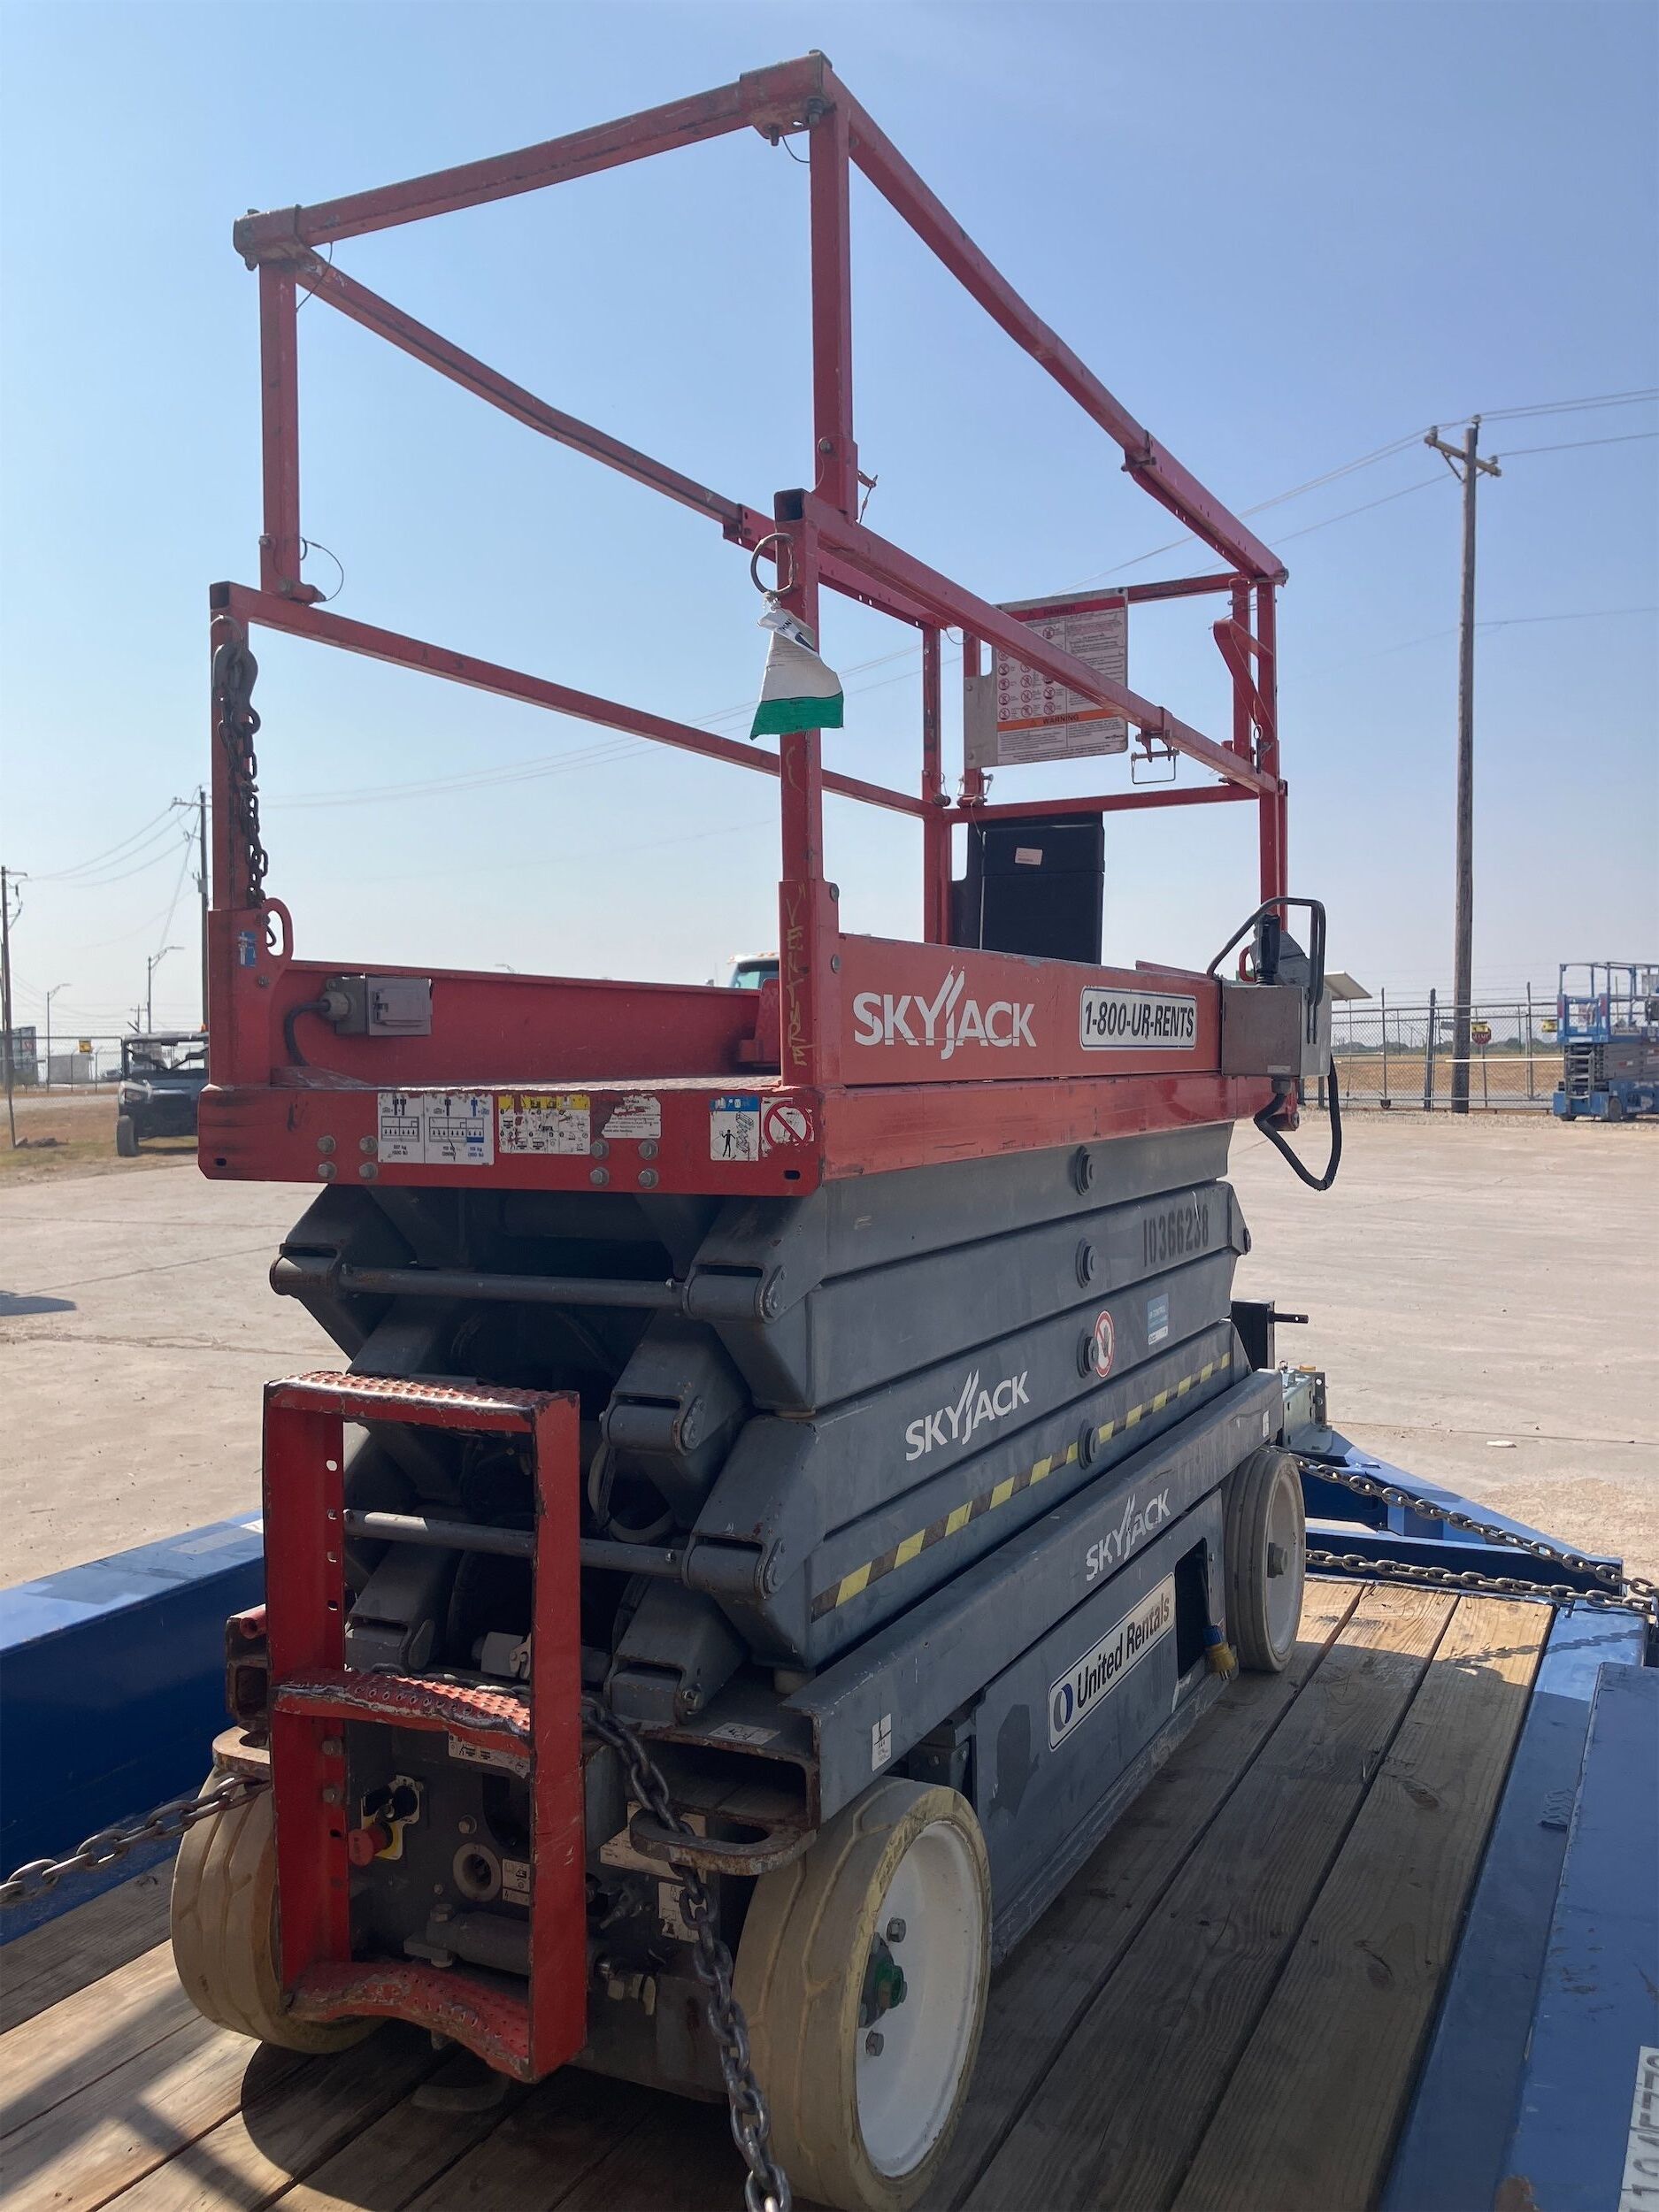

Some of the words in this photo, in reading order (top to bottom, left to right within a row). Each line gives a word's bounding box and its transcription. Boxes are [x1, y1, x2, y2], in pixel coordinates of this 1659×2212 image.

[853, 965, 1036, 1059] SKYJACK
[1085, 1000, 1194, 1040] 1-800-UR-RENTS
[905, 1369, 1030, 1461] SKYJACK
[1086, 1488, 1171, 1582] SKYJACK
[1077, 1632, 1125, 1709] United
[1126, 1593, 1170, 1659] Rentals
